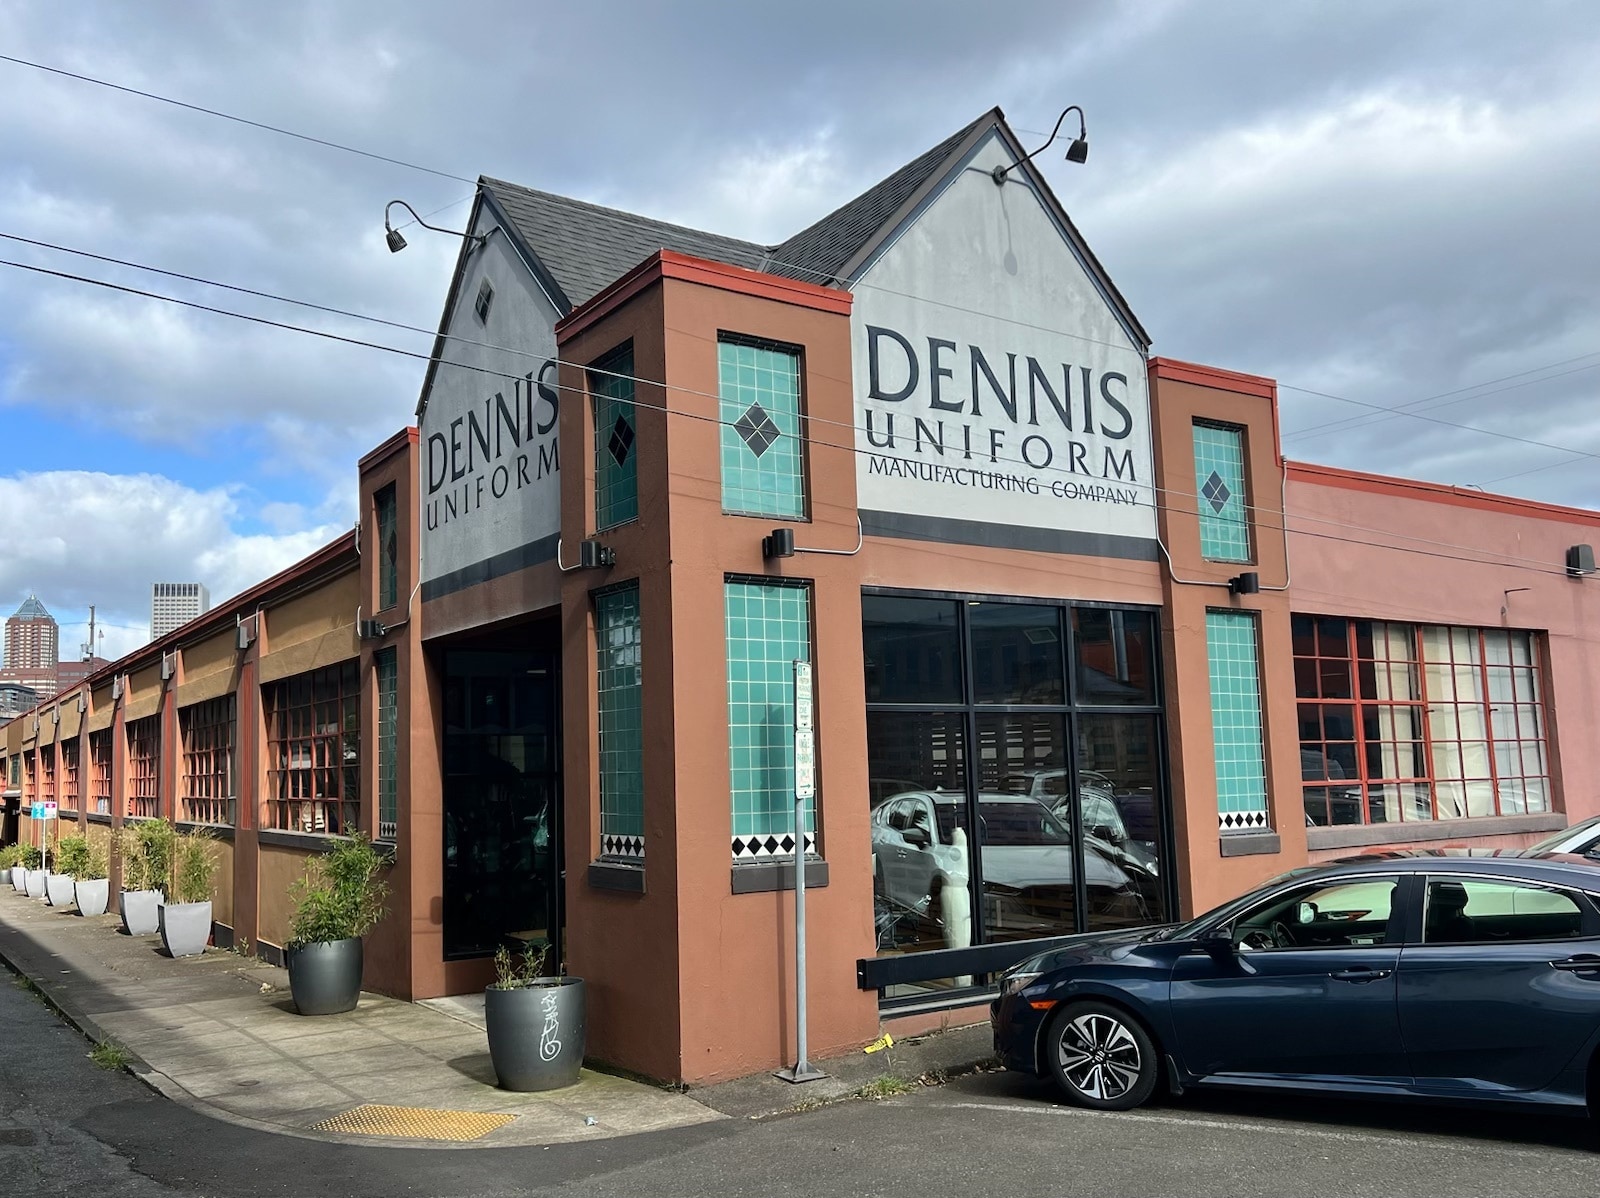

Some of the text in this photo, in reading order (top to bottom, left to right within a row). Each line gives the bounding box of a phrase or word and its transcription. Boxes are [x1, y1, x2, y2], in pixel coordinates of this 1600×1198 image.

[427, 357, 559, 495] DENNIS
[864, 324, 1133, 440] DENNIS
[427, 437, 560, 531] UNIFORM
[864, 409, 1137, 482] UNIFORM
[868, 456, 1138, 506] MANUFACTURING COMPANY
